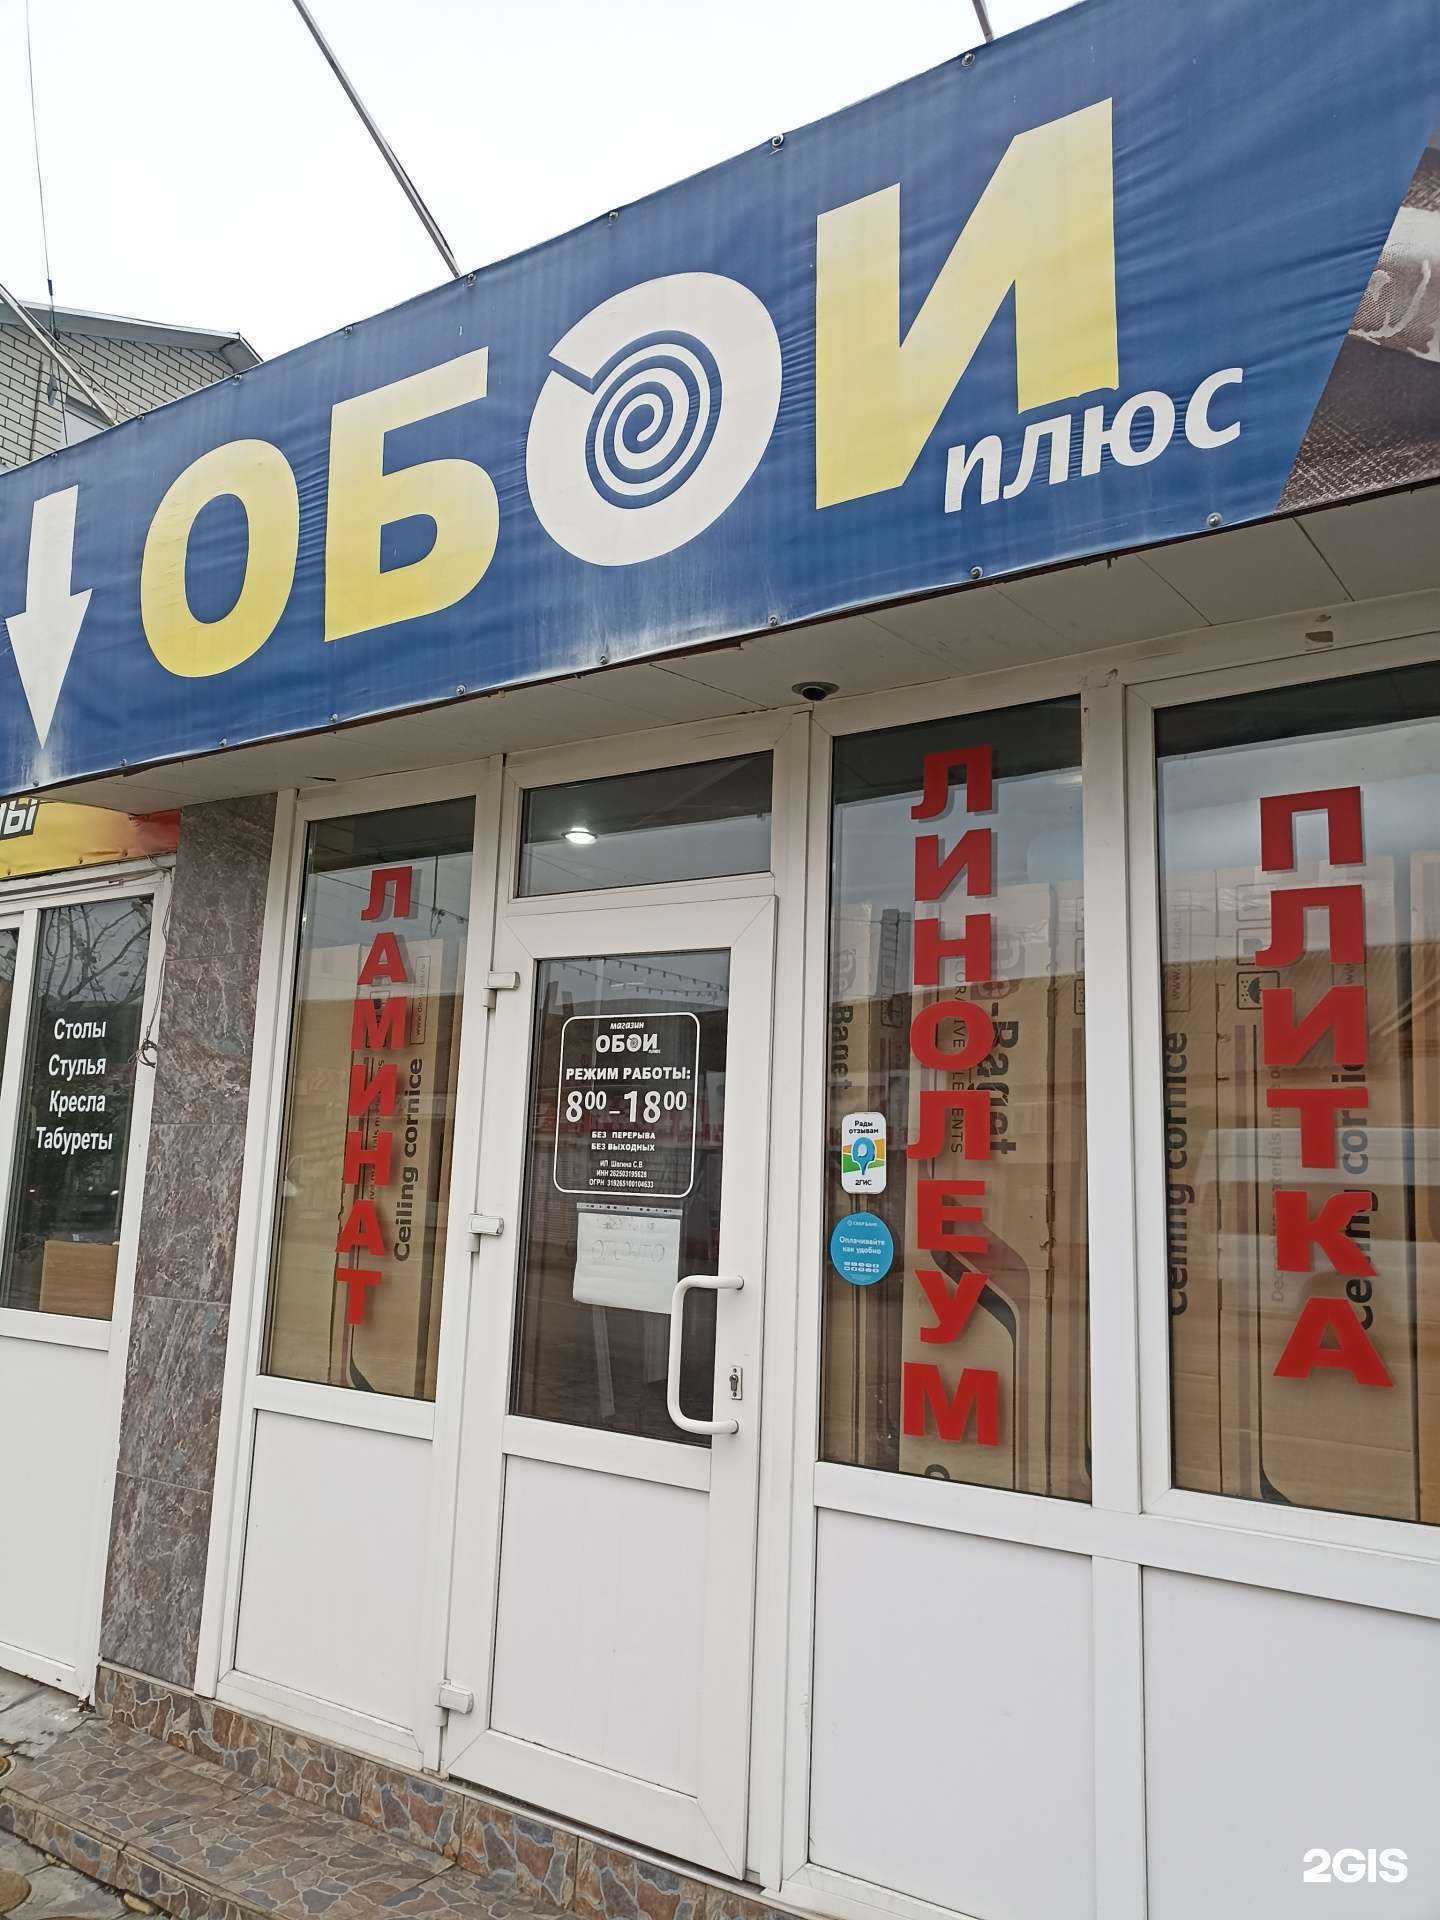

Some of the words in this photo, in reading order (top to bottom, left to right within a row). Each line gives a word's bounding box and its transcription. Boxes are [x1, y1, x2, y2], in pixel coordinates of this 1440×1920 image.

[140, 97, 1119, 678] ОБОИ
[943, 367, 1244, 514] плюс
[54, 1017, 107, 1040] Столы
[610, 1021, 645, 1030] магазин
[595, 1033, 658, 1053] ОБОИ
[48, 1053, 107, 1081] Стулья
[565, 1067, 619, 1081] РЕЖИМ
[622, 1066, 691, 1080] РАБОТЫ:
[335, 865, 413, 1325] ЛАМИНАТ
[904, 744, 999, 1446] ЛИНОЛЕУМ
[1255, 785, 1394, 1389] ПЛИТКА
[49, 1090, 106, 1117] Кресла
[405, 1058, 423, 1158] cornice
[591, 1131, 607, 1139] БЕЗ
[611, 1131, 656, 1140] ПЕРЕРЫВА
[848, 1127, 879, 1135] отзывам
[854, 1120, 873, 1128] Рады
[36, 1126, 113, 1155] Табуреты
[591, 1143, 606, 1151] БЕЗ
[607, 1143, 656, 1152] ВЫХОДНЫХ
[588, 1178, 605, 1186] ОГРН
[596, 1169, 609, 1177] ИНН
[393, 1166, 419, 1262] Ceiling
[839, 1236, 885, 1246] Оплачивайте
